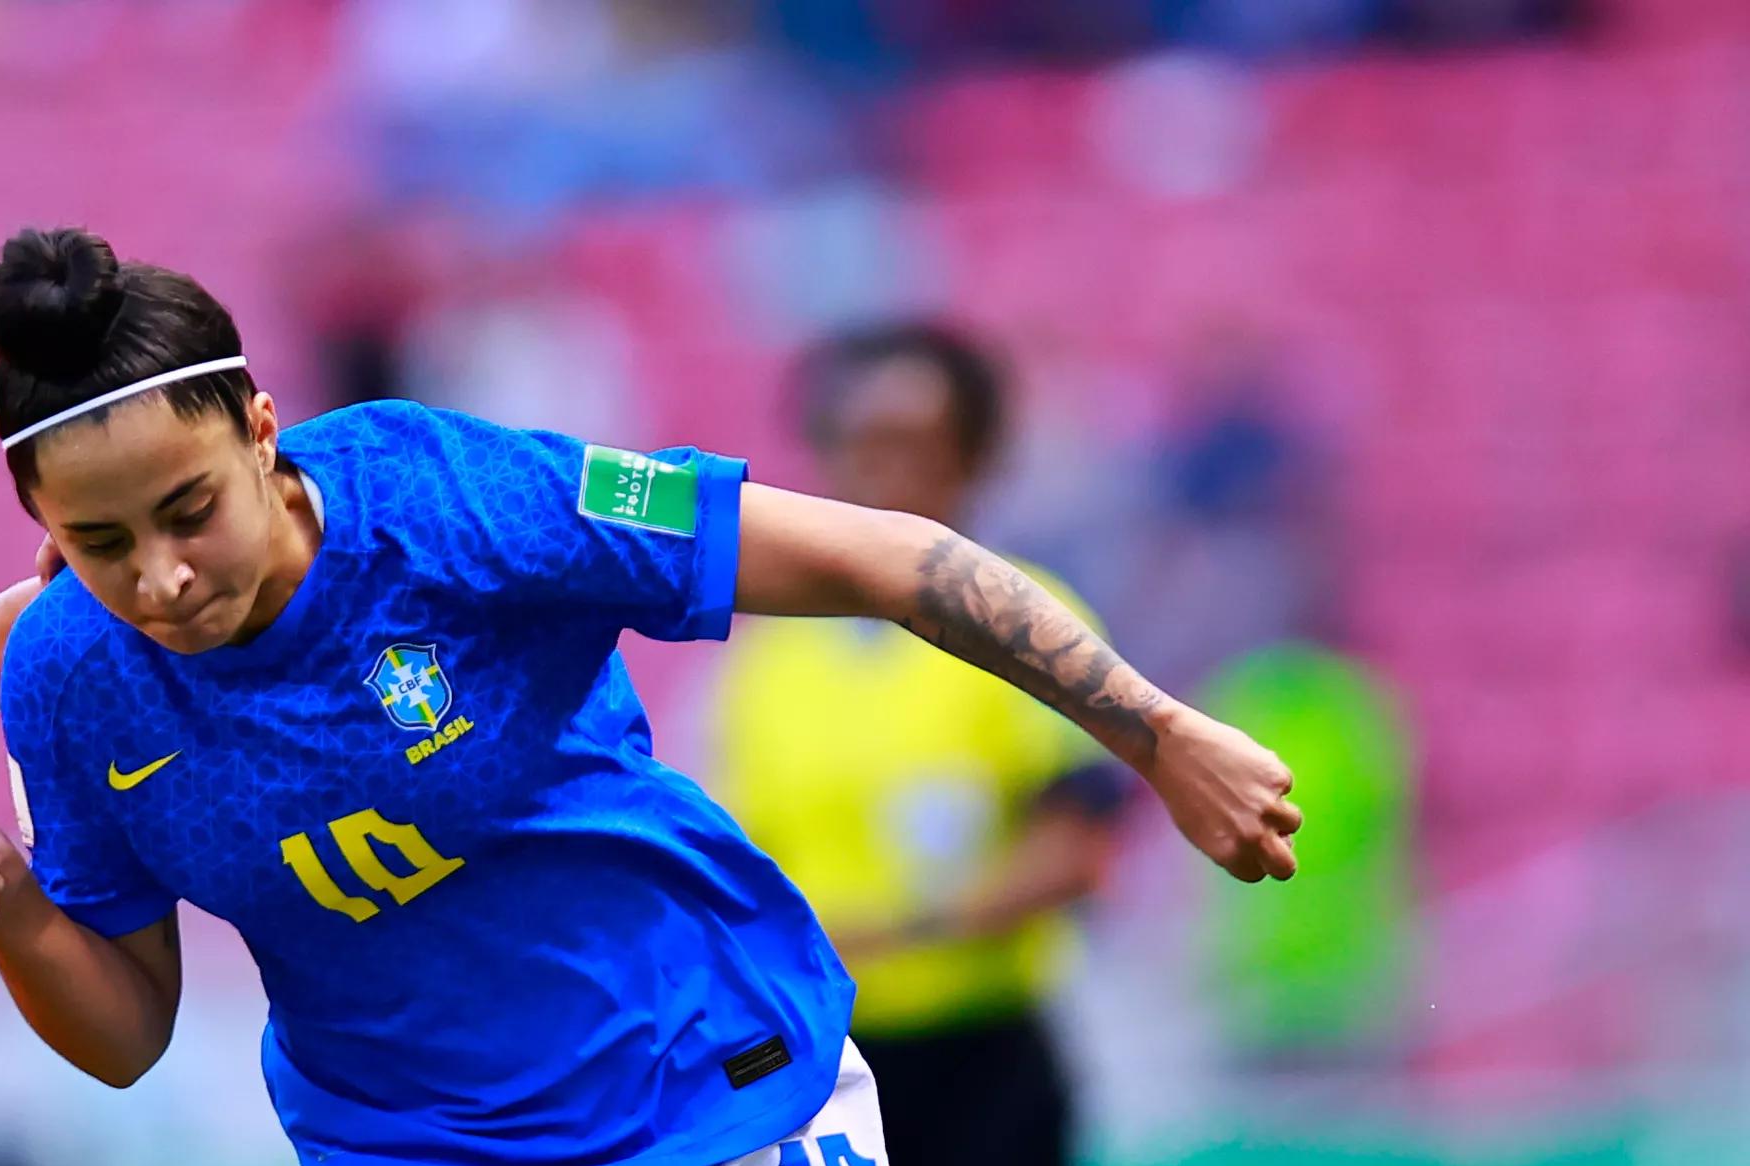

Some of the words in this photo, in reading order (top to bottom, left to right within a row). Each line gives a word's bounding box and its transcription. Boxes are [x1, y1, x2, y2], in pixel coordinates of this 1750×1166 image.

[397, 675, 424, 694] CBF
[405, 715, 474, 765] BRASIL
[280, 807, 466, 923] 10
